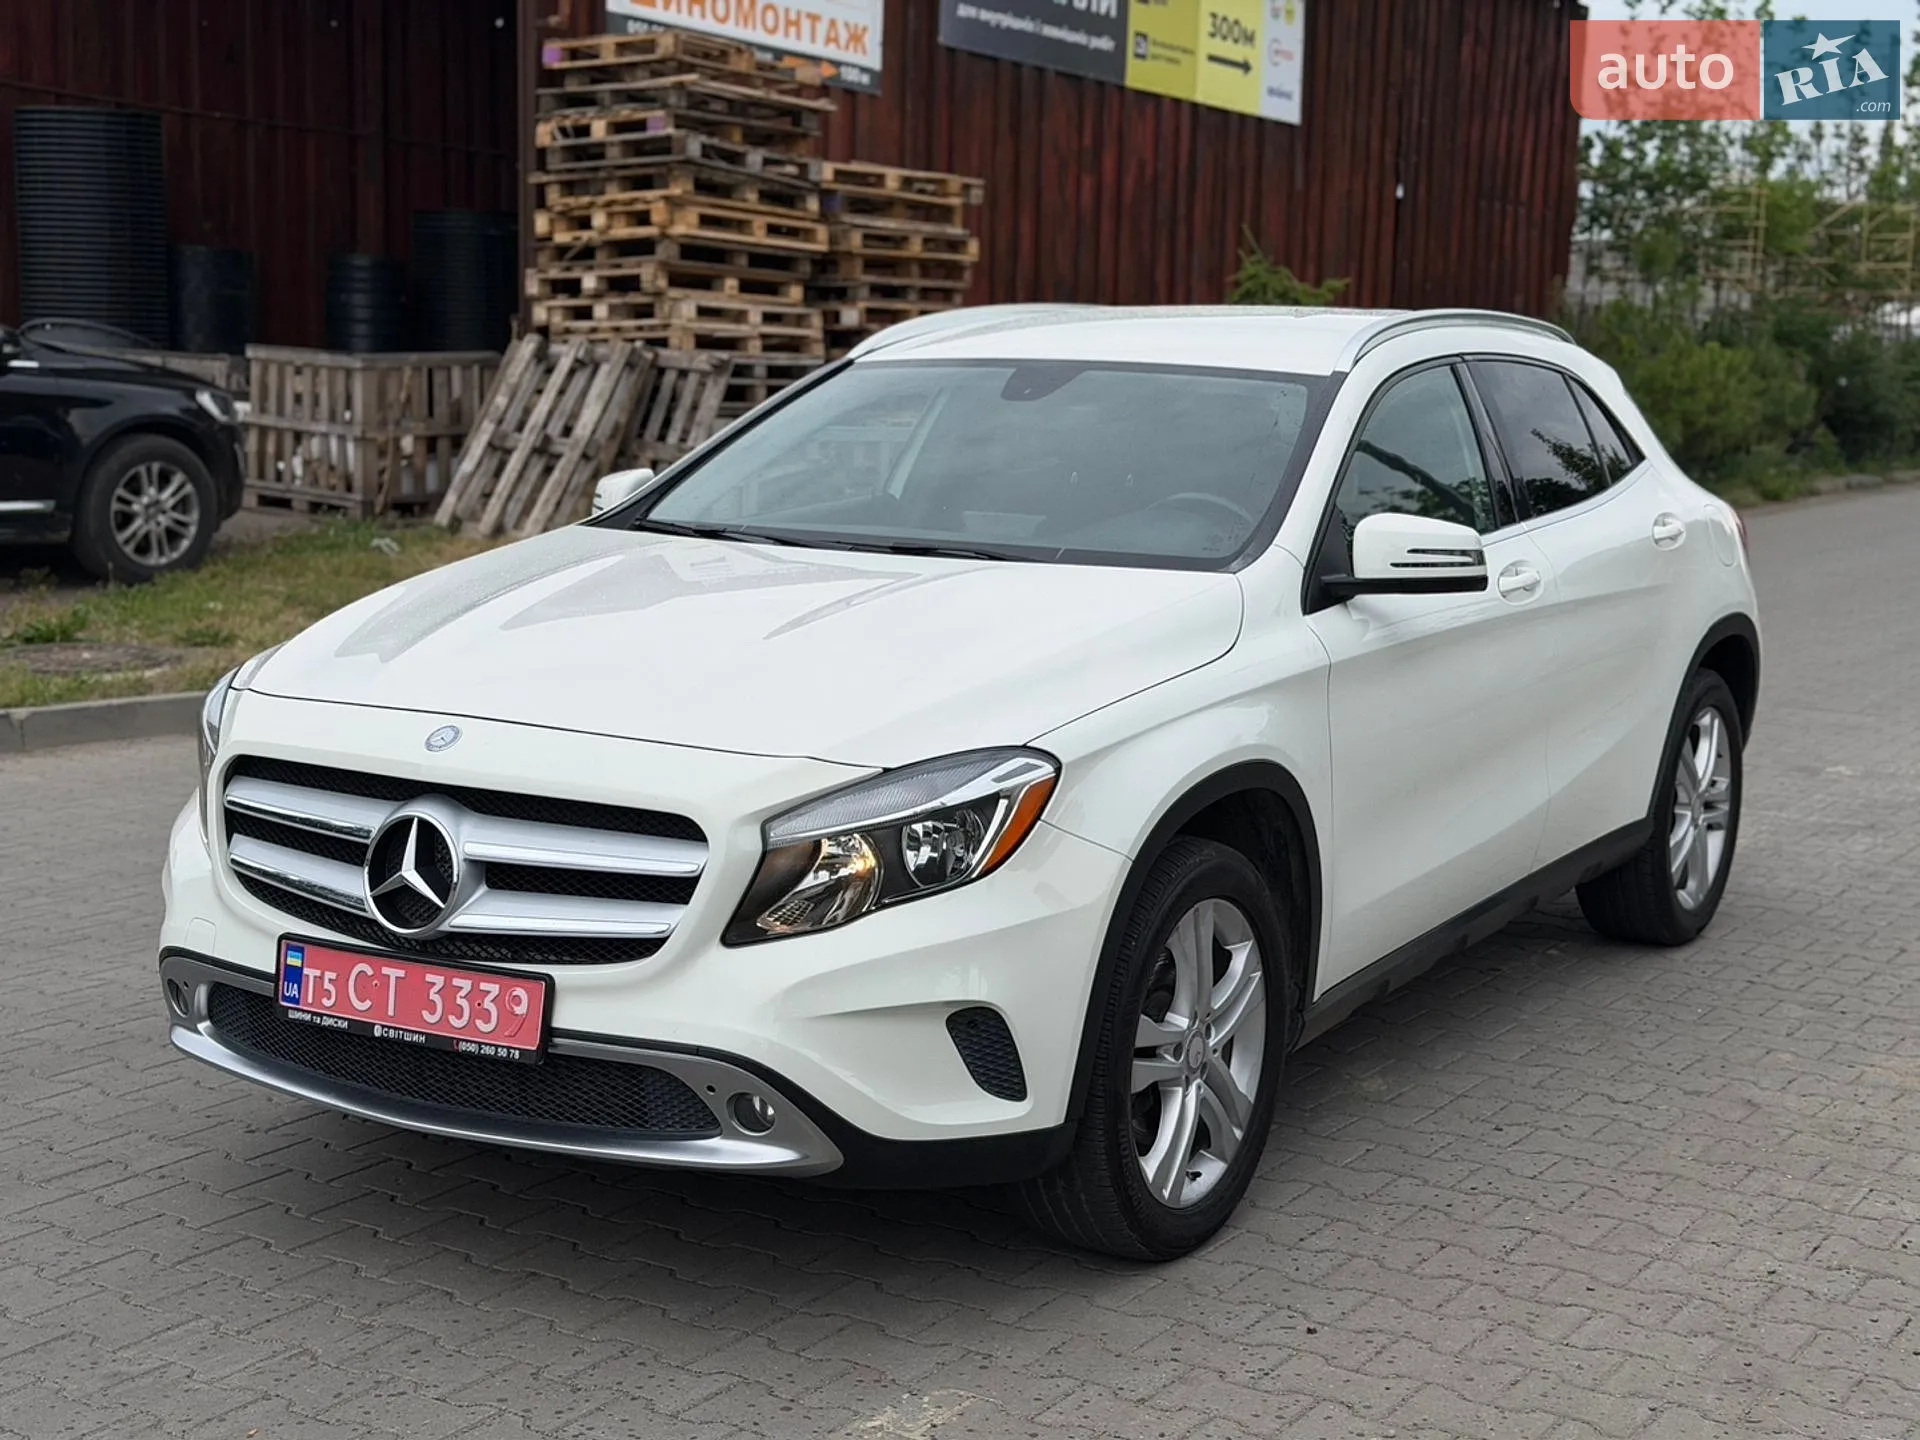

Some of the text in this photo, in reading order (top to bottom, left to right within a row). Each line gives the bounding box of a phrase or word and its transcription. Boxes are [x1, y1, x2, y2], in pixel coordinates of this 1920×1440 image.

[629, 0, 869, 56] НОМОНТАЖ
[284, 981, 299, 999] UA
[303, 962, 529, 1037] T5 CT 3339
